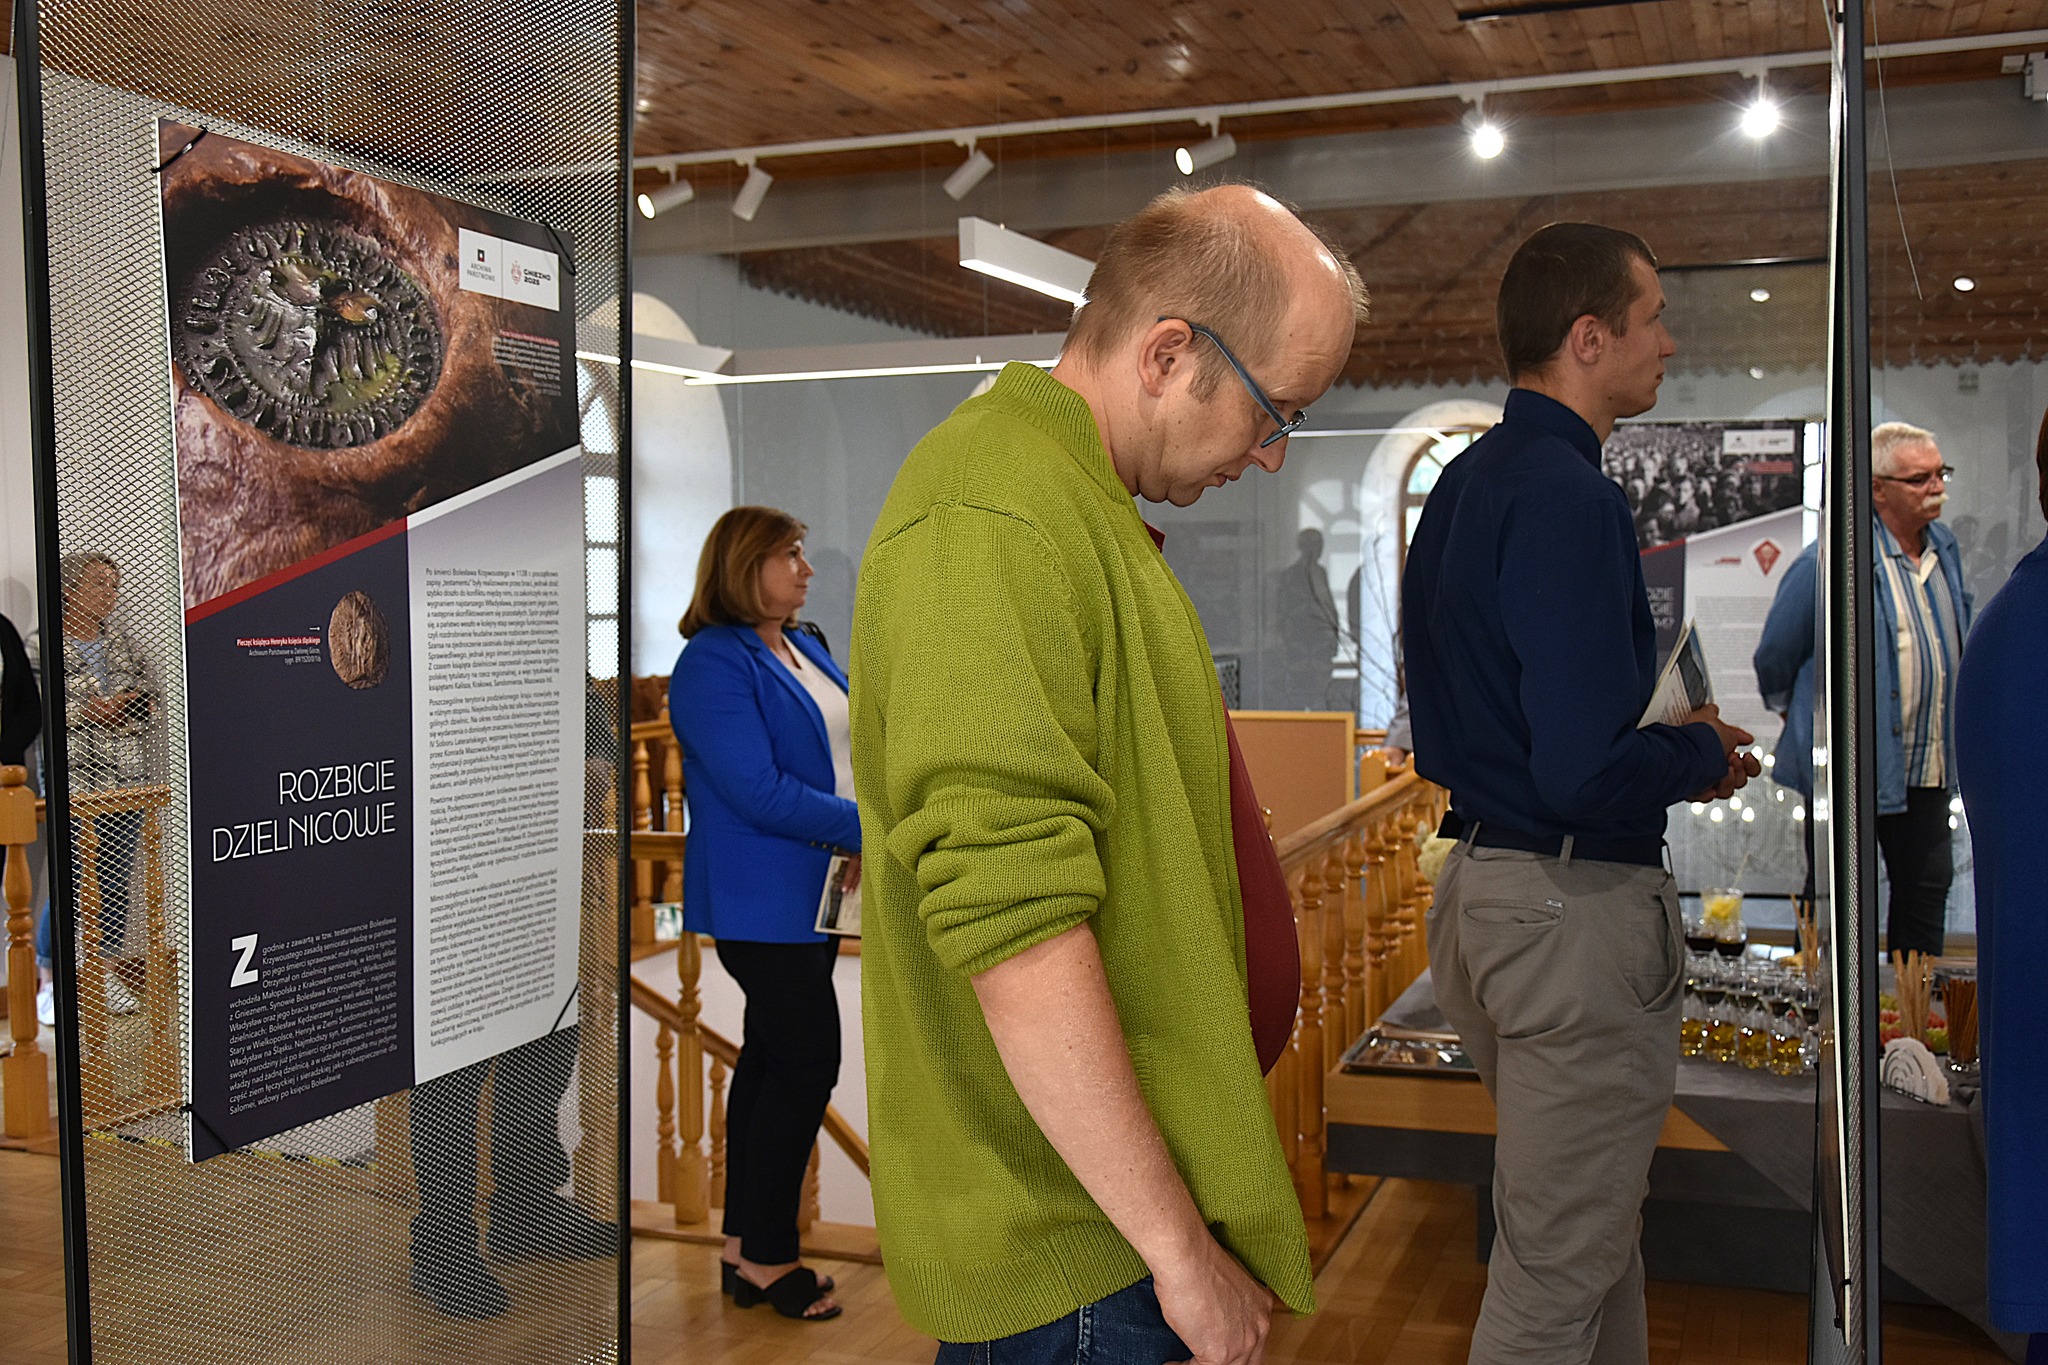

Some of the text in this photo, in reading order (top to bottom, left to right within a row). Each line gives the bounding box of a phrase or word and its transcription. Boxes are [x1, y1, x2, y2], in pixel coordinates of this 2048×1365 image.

[524, 269, 551, 280] GNIEZNO
[524, 276, 540, 285] 2025
[236, 639, 252, 647] Pieczęć
[253, 638, 270, 647] książęca
[302, 637, 320, 645] śląskiego
[280, 760, 396, 805] ROZBICIE
[213, 802, 396, 862] DZIELNICOWE
[262, 943, 284, 956] godnie
[291, 936, 313, 947] zawartą
[334, 923, 367, 937] testamencie
[369, 917, 396, 928] Bolesława
[262, 951, 302, 966] Krzywoustego
[303, 944, 322, 955] zasadą
[230, 933, 259, 988] Z
[262, 970, 270, 979] po
[272, 966, 285, 977] jego
[286, 960, 305, 971] śmierci
[307, 951, 336, 967] sprawować
[262, 974, 290, 988] Otrzymał
[301, 967, 326, 979] dzielnicę
[328, 959, 357, 971] senioralną,
[229, 994, 260, 1009] wchodziła
[262, 985, 296, 1000] Małopolska
[302, 977, 332, 989] Krakowem
[333, 973, 345, 981] oraz
[346, 967, 361, 978] część
[362, 958, 396, 973] Wielkopolski
[234, 1006, 268, 1019] Gnieznem.
[269, 997, 294, 1011] Synowie
[296, 990, 325, 1002] Bolesława
[326, 978, 365, 994] Krzywoustego
[229, 1018, 261, 1032] Władysław
[263, 1014, 275, 1023] oraz
[276, 1010, 290, 1021] jego
[291, 1005, 308, 1015] bracia
[309, 994, 340, 1011] sprawować
[229, 1026, 266, 1044] dzielnicach:
[269, 1020, 296, 1033] Bolesław
[297, 1009, 333, 1026] Kędzierzawy
[343, 999, 373, 1011] Mazowszu,
[374, 990, 396, 1002] Mieszko
[229, 1046, 245, 1056] Stary
[252, 1032, 293, 1049] Wielkopolsce,
[295, 1024, 315, 1037] Henryk
[322, 1018, 337, 1029] Ziemi
[338, 1006, 380, 1024] Sandomierskiej,
[229, 1053, 262, 1067] Władysław
[273, 1043, 292, 1055] Śląsku.
[294, 1033, 327, 1048] Najmłodszy
[329, 1030, 339, 1039] syn,
[340, 1022, 367, 1034] Kazimierz,
[229, 1068, 247, 1079] swoje
[248, 1059, 278, 1073] narodziny
[279, 1054, 287, 1066] już
[289, 1054, 297, 1063] po
[298, 1046, 318, 1058] śmierci
[319, 1044, 331, 1053] ojca
[332, 1033, 364, 1050] początkowo
[229, 1079, 250, 1091] władzy
[252, 1073, 263, 1084] nad
[264, 1069, 282, 1080] żadną
[283, 1062, 309, 1074] dzielnicą,
[321, 1050, 340, 1062] udziale
[342, 1042, 368, 1058] przypadła
[229, 1090, 247, 1102] część
[248, 1087, 264, 1096] ziem
[265, 1075, 294, 1093] łęczyckiej
[300, 1064, 330, 1080] sieradzkiej
[332, 1060, 344, 1072] jako
[345, 1047, 387, 1066] zabezpieczenie
[388, 1044, 397, 1052] dla
[229, 1073, 341, 1114] Salomei, wdowy po księciu Bolesławie
